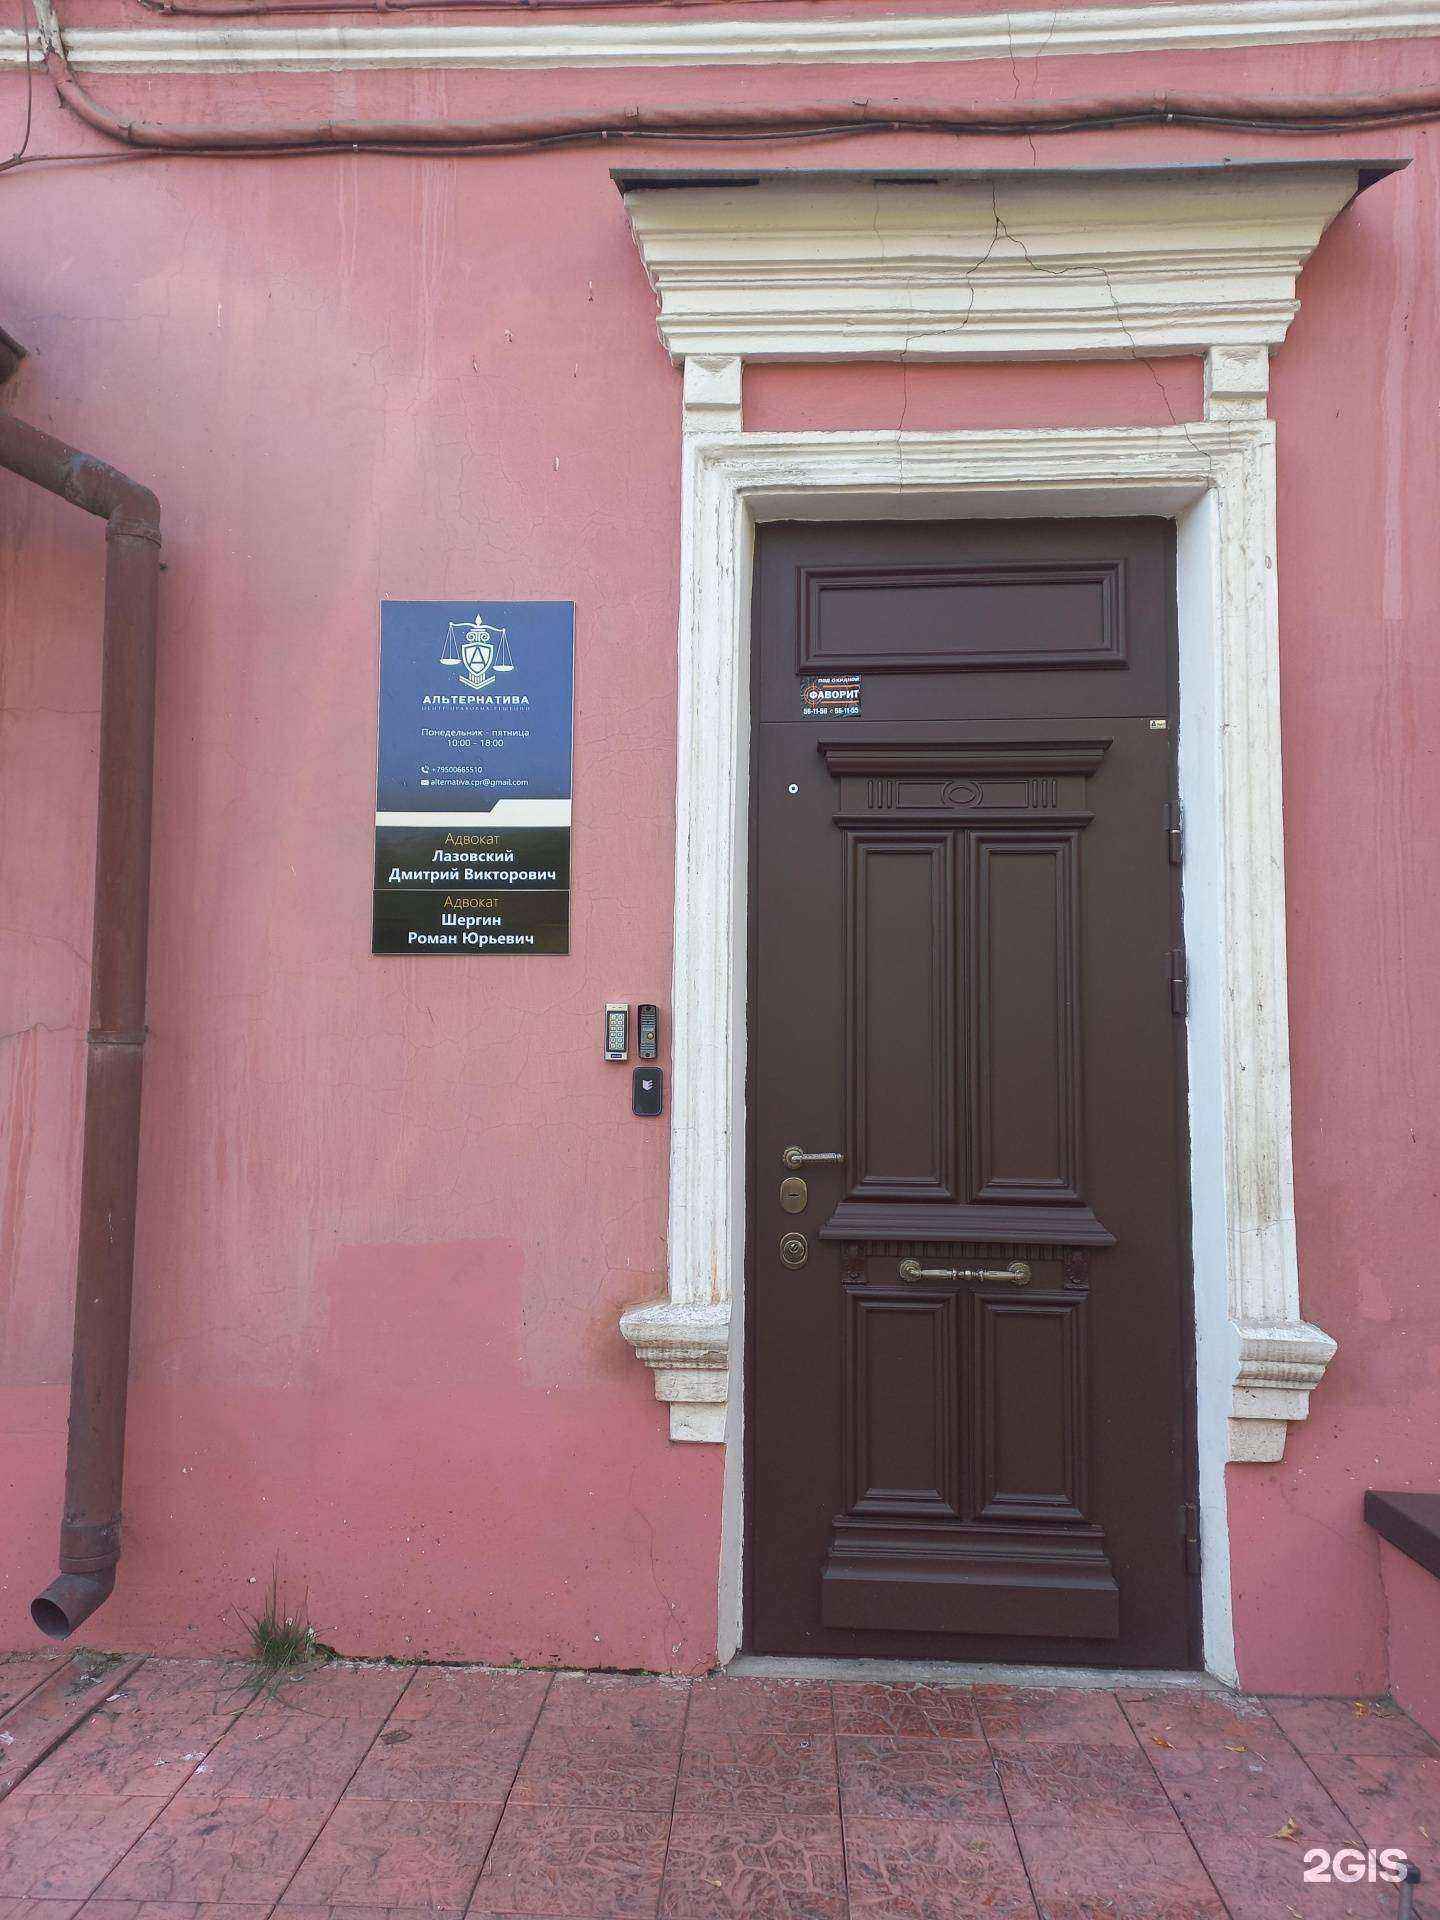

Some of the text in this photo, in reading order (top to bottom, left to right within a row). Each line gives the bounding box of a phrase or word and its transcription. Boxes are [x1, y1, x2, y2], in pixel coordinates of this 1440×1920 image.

[422, 695, 530, 705] АЛЬТЕРНАТИВА
[809, 689, 860, 699] ФАВОРИТ
[421, 728, 483, 738] Понедельник
[492, 730, 530, 738] пятница
[447, 739, 471, 747] 10:00
[480, 739, 504, 747] 18:00
[444, 833, 500, 845] Адвокат
[432, 849, 514, 862] Лазовский
[389, 867, 556, 883] Дмитрий Викторович
[443, 896, 499, 909] Адвокат
[441, 913, 501, 929] Шергин
[408, 932, 534, 947] Роман Юрьевич
